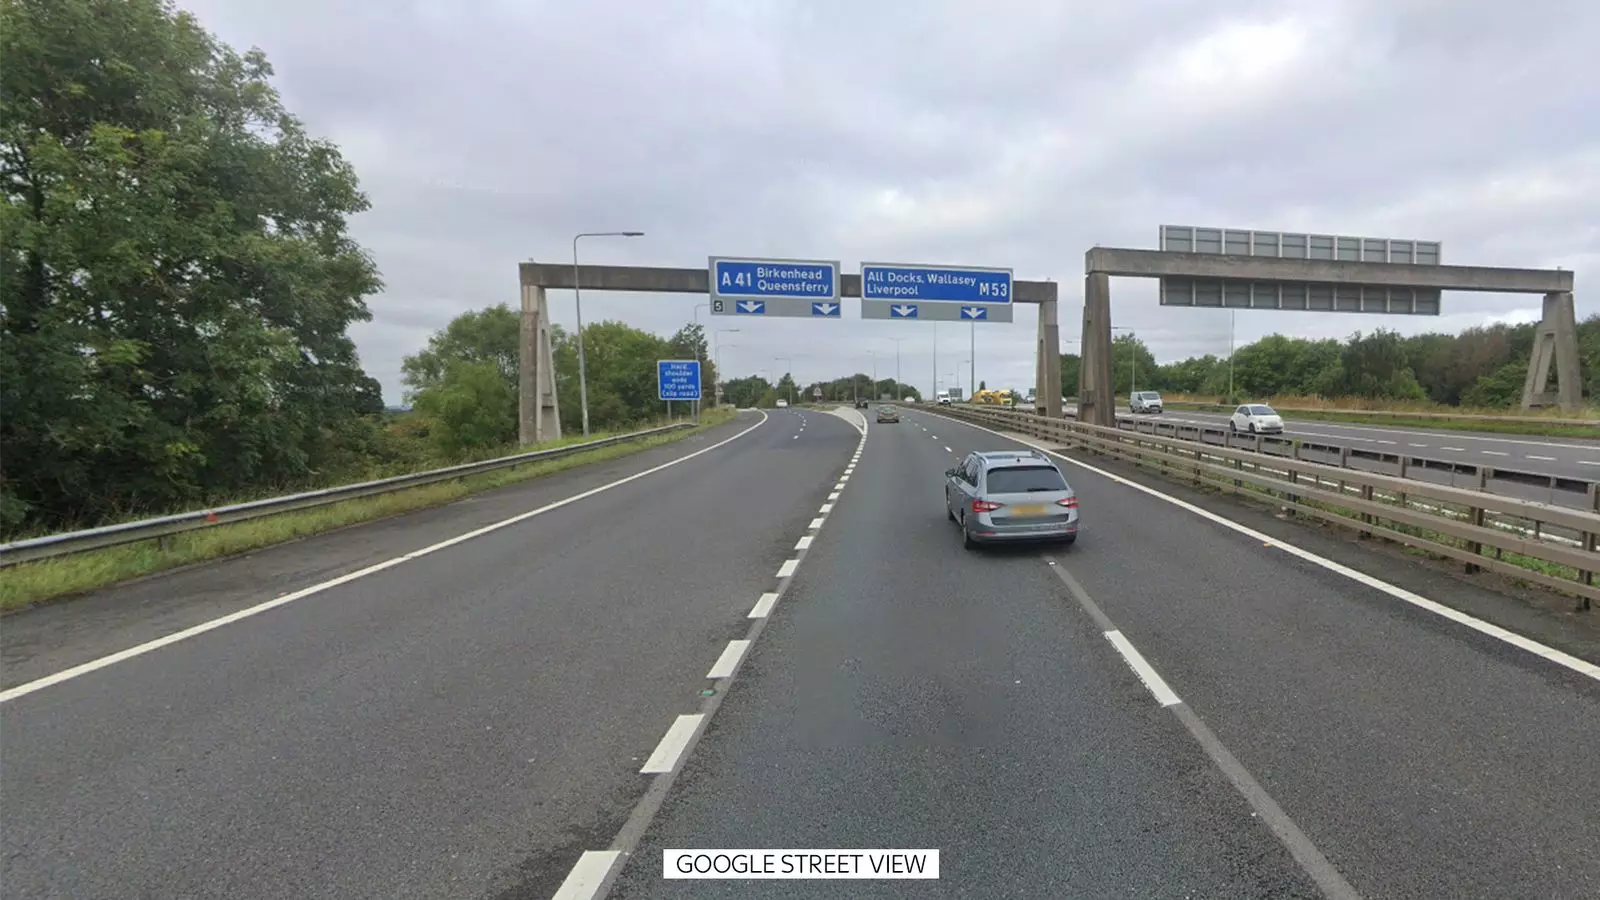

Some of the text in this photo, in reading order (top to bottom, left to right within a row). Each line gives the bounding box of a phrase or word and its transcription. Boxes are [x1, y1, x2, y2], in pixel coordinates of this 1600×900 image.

[722, 272, 752, 287] A 41
[757, 267, 822, 280] Birkenhead
[867, 271, 884, 282] All
[927, 273, 976, 287] Wallasey
[757, 280, 829, 294] Queensferry
[867, 284, 918, 296] Liverpool
[715, 302, 722, 311] 5
